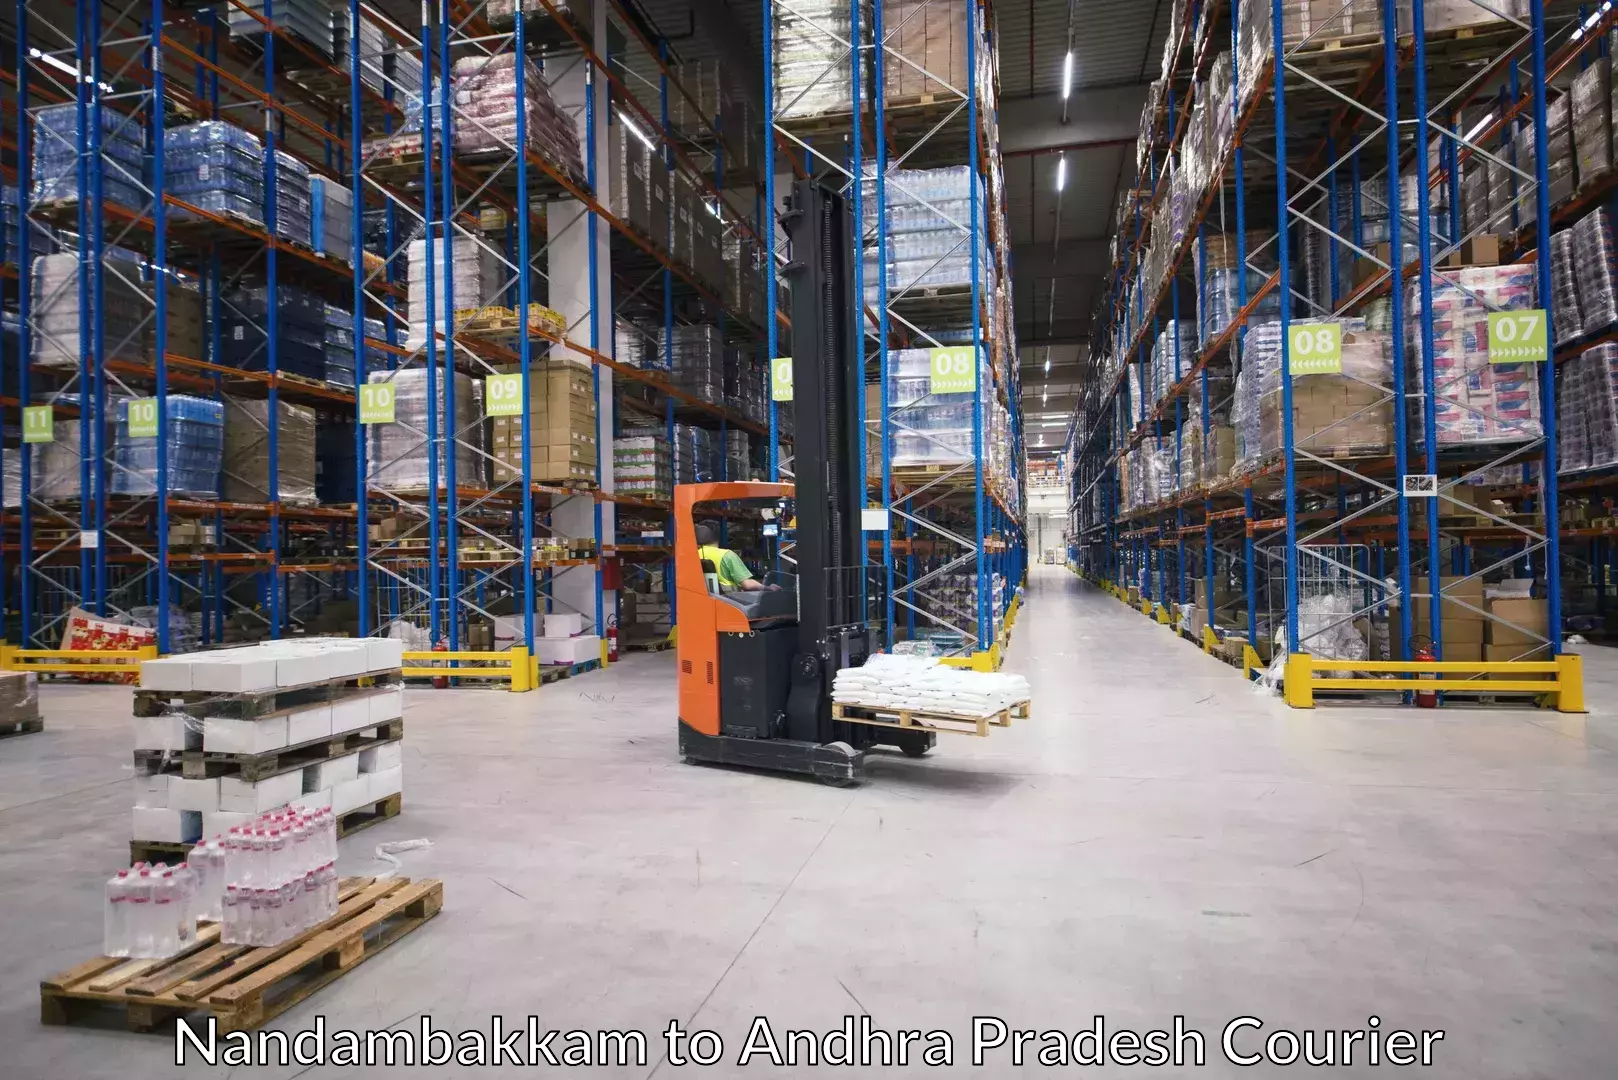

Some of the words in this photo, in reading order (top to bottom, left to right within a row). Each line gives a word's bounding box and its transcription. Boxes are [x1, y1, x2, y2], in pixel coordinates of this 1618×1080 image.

[1496, 317, 1538, 343] 07
[1294, 330, 1335, 355] 08
[777, 363, 793, 383] 0
[936, 352, 971, 376] 08
[364, 388, 390, 408] 10
[491, 380, 518, 399] 09
[28, 411, 48, 428] 11
[132, 404, 155, 422] 10
